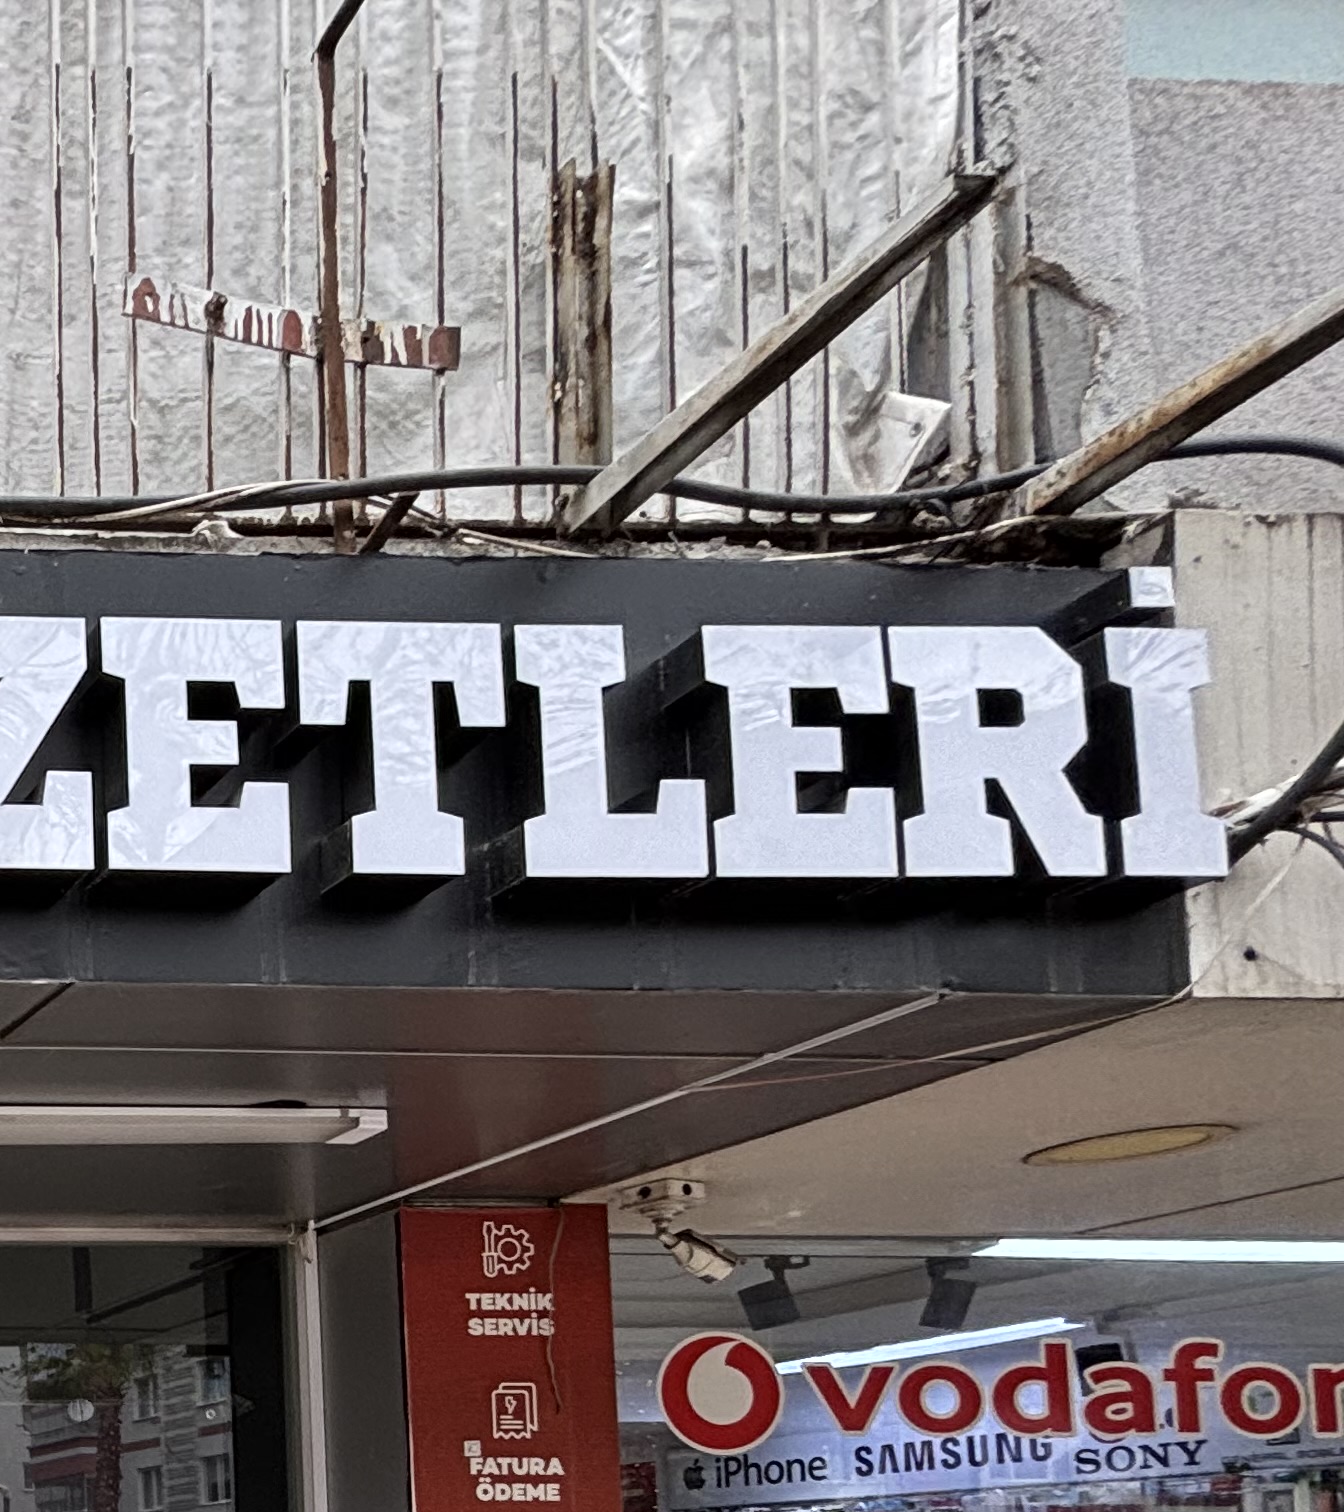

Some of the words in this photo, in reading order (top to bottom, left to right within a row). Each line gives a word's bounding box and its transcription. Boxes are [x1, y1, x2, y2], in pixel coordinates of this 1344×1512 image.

[465, 1287, 555, 1311] TEKNİK
[467, 1313, 555, 1336] SERVİS
[469, 1456, 565, 1476] FATURA
[715, 1453, 828, 1489] iPhone
[855, 1433, 1053, 1477] SAMSUNG
[1074, 1439, 1209, 1475] SONY
[476, 1477, 561, 1501] ÖDEME
